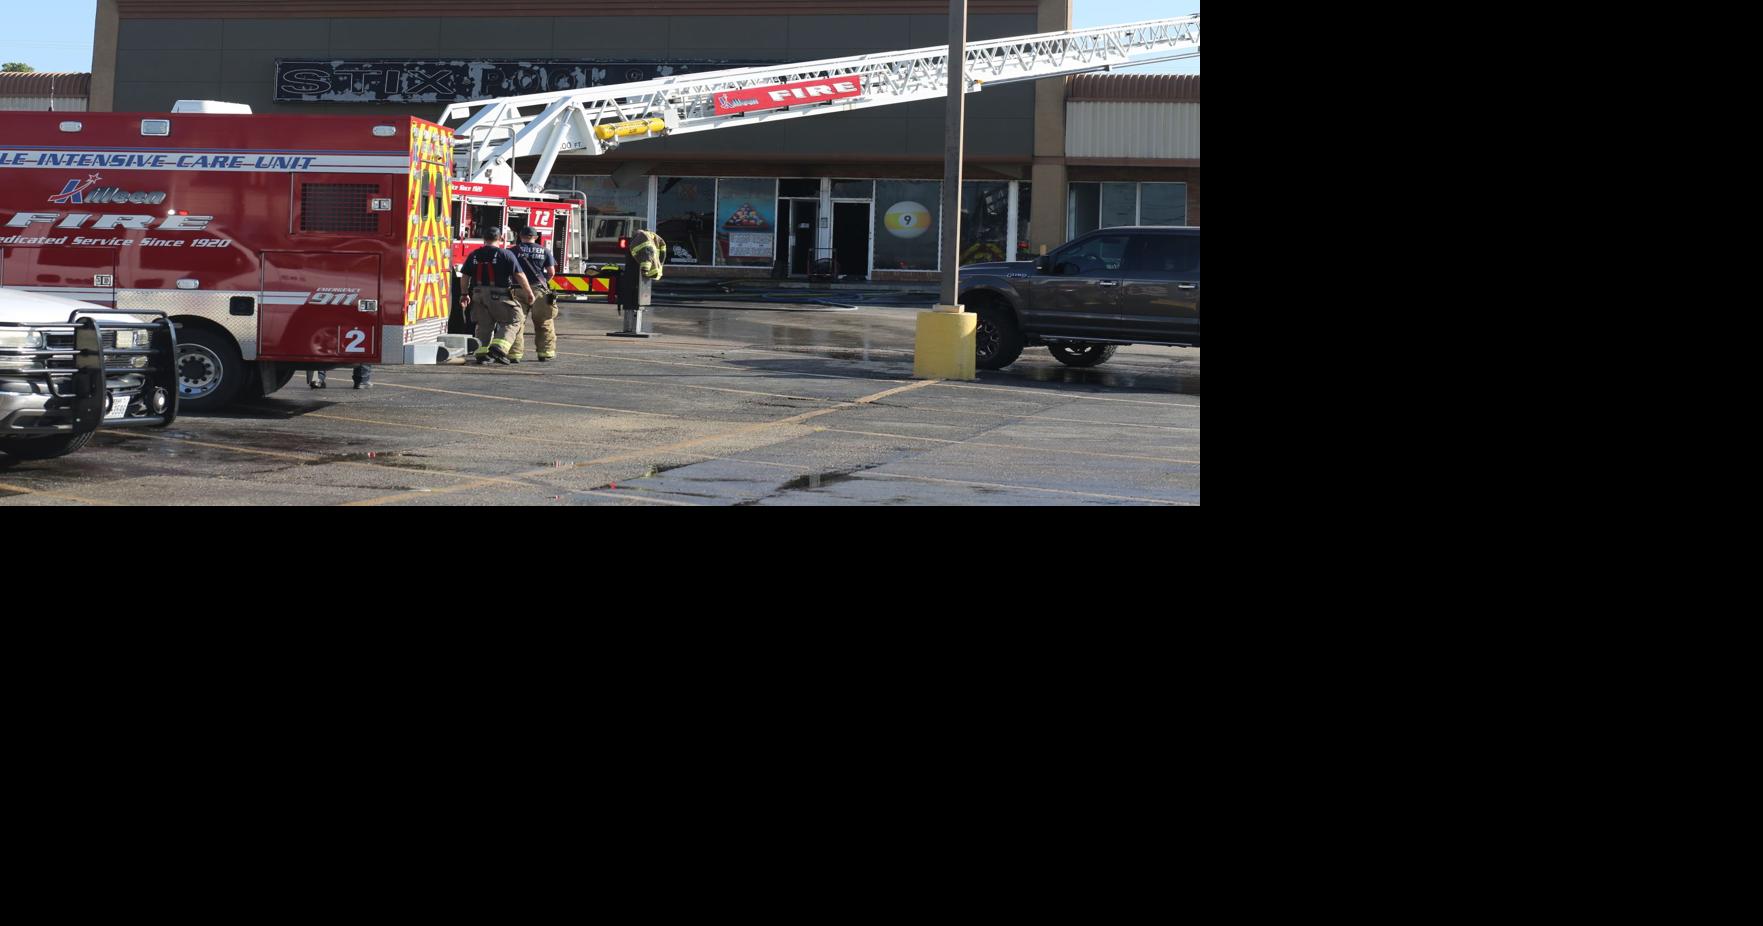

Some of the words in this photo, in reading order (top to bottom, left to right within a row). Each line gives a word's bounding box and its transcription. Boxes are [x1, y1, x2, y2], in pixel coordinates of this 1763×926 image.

[281, 68, 457, 95] STIX
[768, 81, 858, 102] FIRE
[37, 153, 168, 167] INTENSIVE
[176, 155, 245, 168] CARE
[255, 156, 317, 170] UNIT
[48, 178, 167, 204] Killeen
[4, 211, 214, 231] FIRE
[533, 210, 551, 226] T2
[903, 215, 913, 226] 9
[72, 236, 135, 247] Service
[140, 237, 187, 248] Since
[190, 238, 232, 249] 1920
[309, 292, 359, 305] 911
[344, 329, 366, 353] 2
